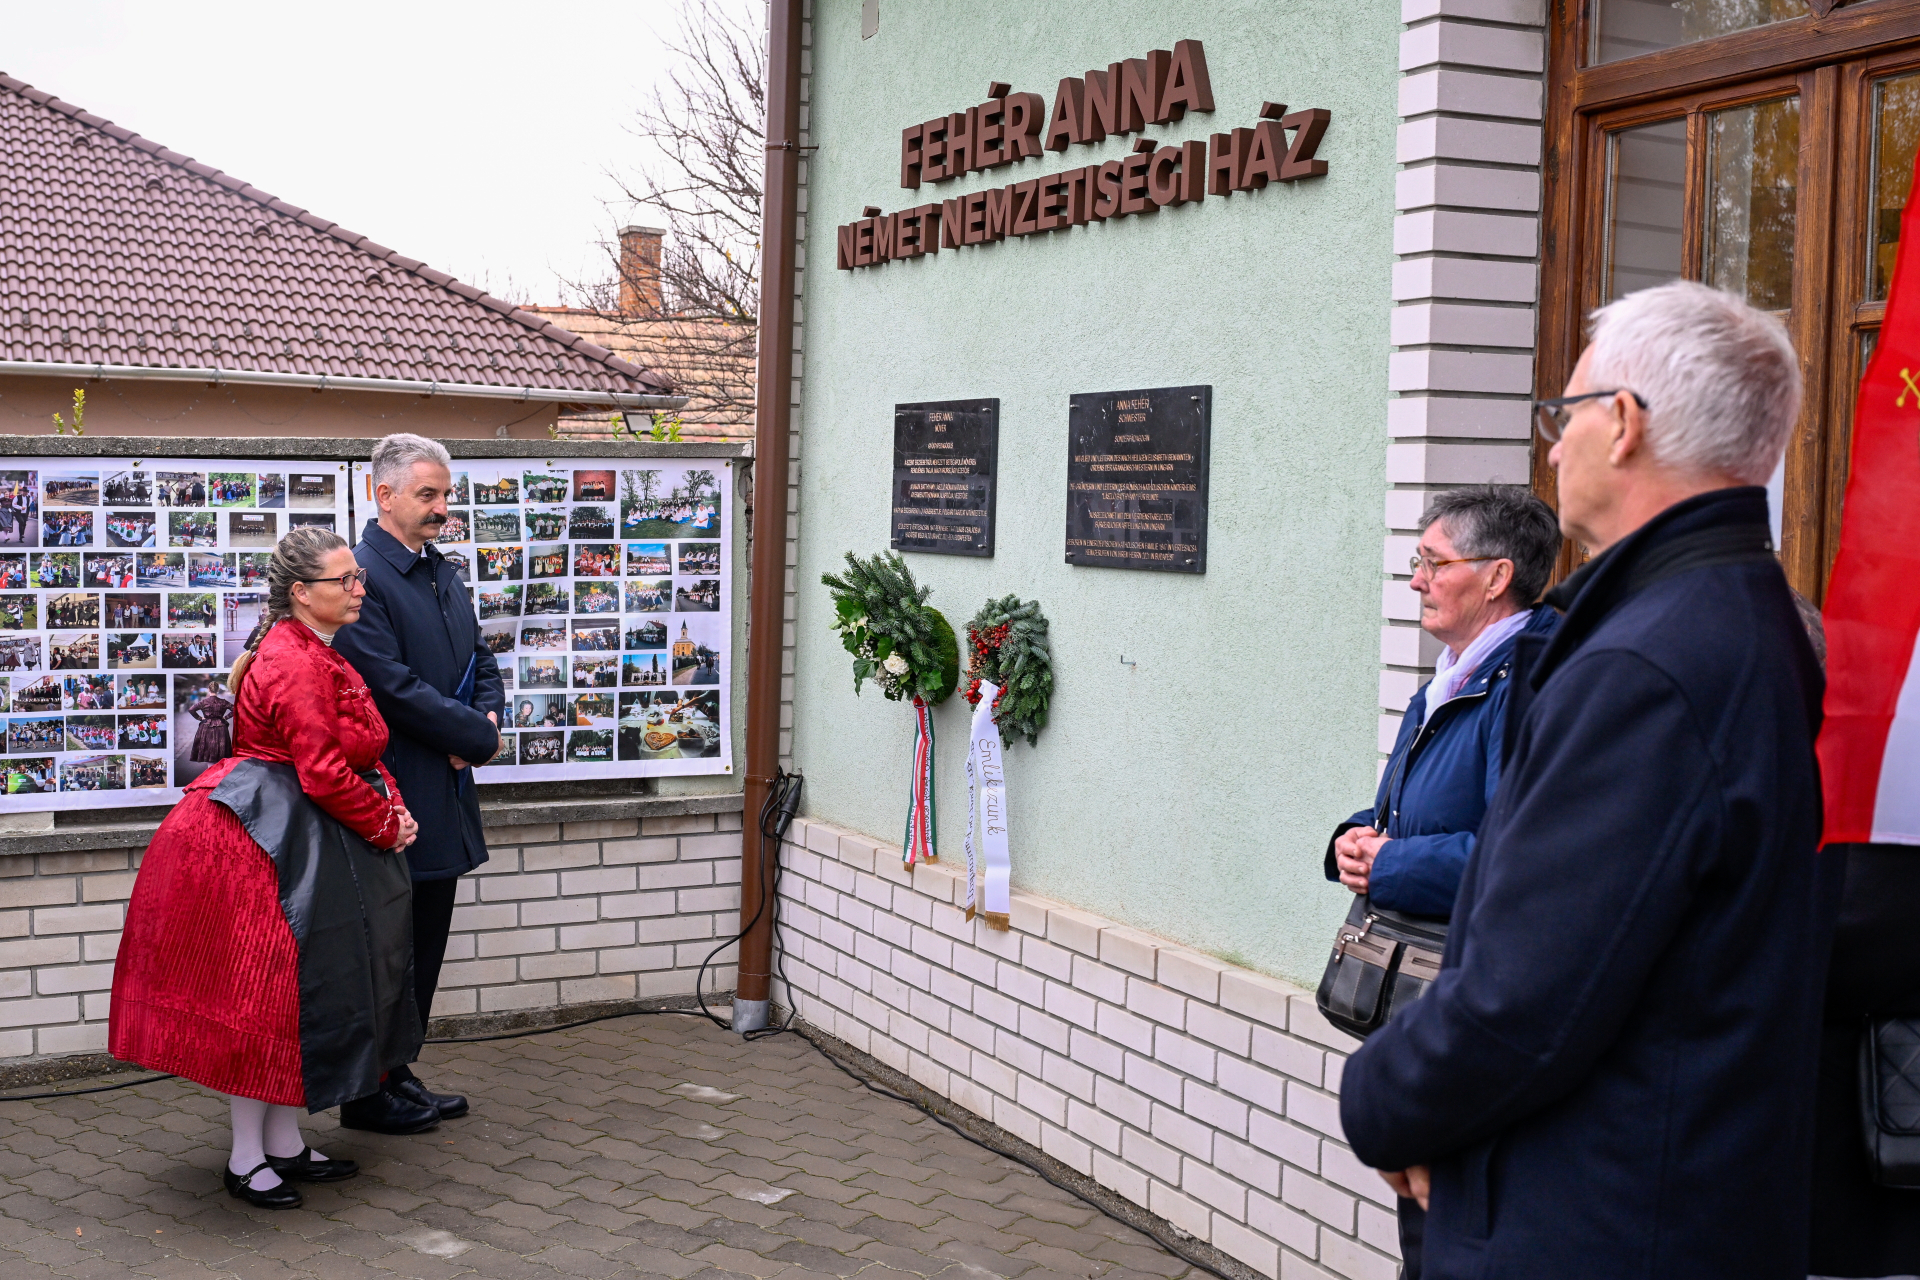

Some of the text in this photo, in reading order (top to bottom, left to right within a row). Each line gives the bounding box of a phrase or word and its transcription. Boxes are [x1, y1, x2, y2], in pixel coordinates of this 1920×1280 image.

[901, 38, 1216, 189] FEHÉR ANNA
[837, 101, 1332, 271] NÉMET NEMZETISÉGI HÁZ
[1116, 399, 1132, 411] ANNA
[1118, 412, 1147, 423] SCHWESTER
